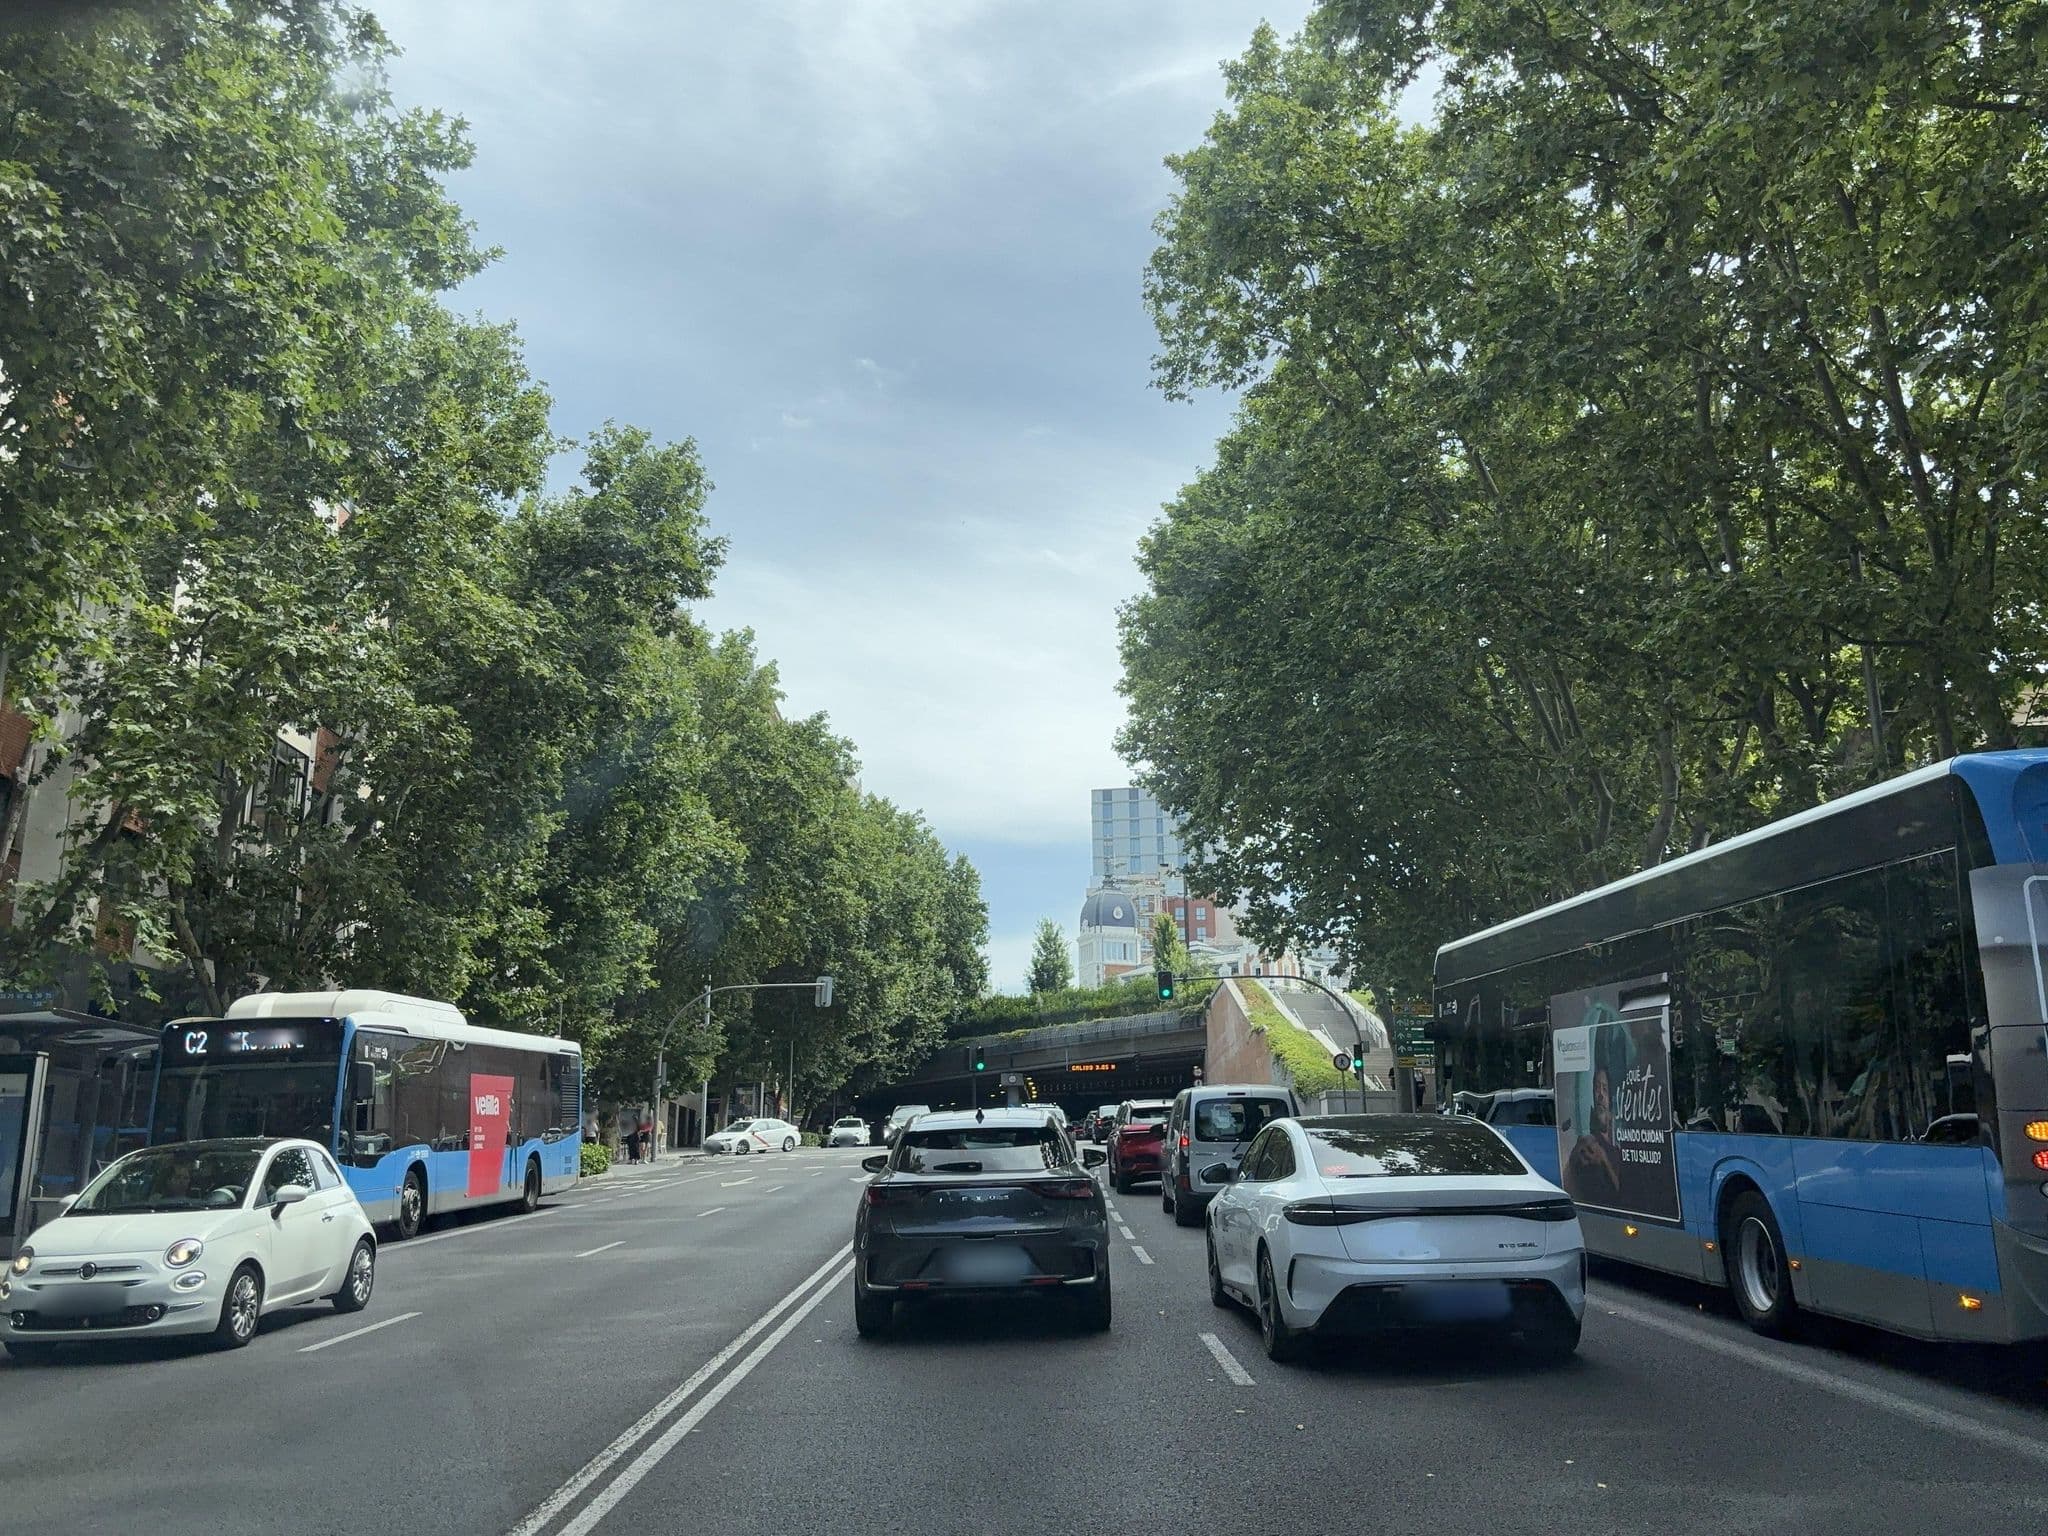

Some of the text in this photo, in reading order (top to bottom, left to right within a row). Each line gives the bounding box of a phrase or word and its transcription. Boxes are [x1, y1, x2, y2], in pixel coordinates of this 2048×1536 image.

[185, 1031, 208, 1054] C2
[1616, 1064, 1662, 1122] sientes
[1616, 1128, 1665, 1143] CUANDO CUIDAN
[1622, 1149, 1662, 1164] DE TU SALUD?
